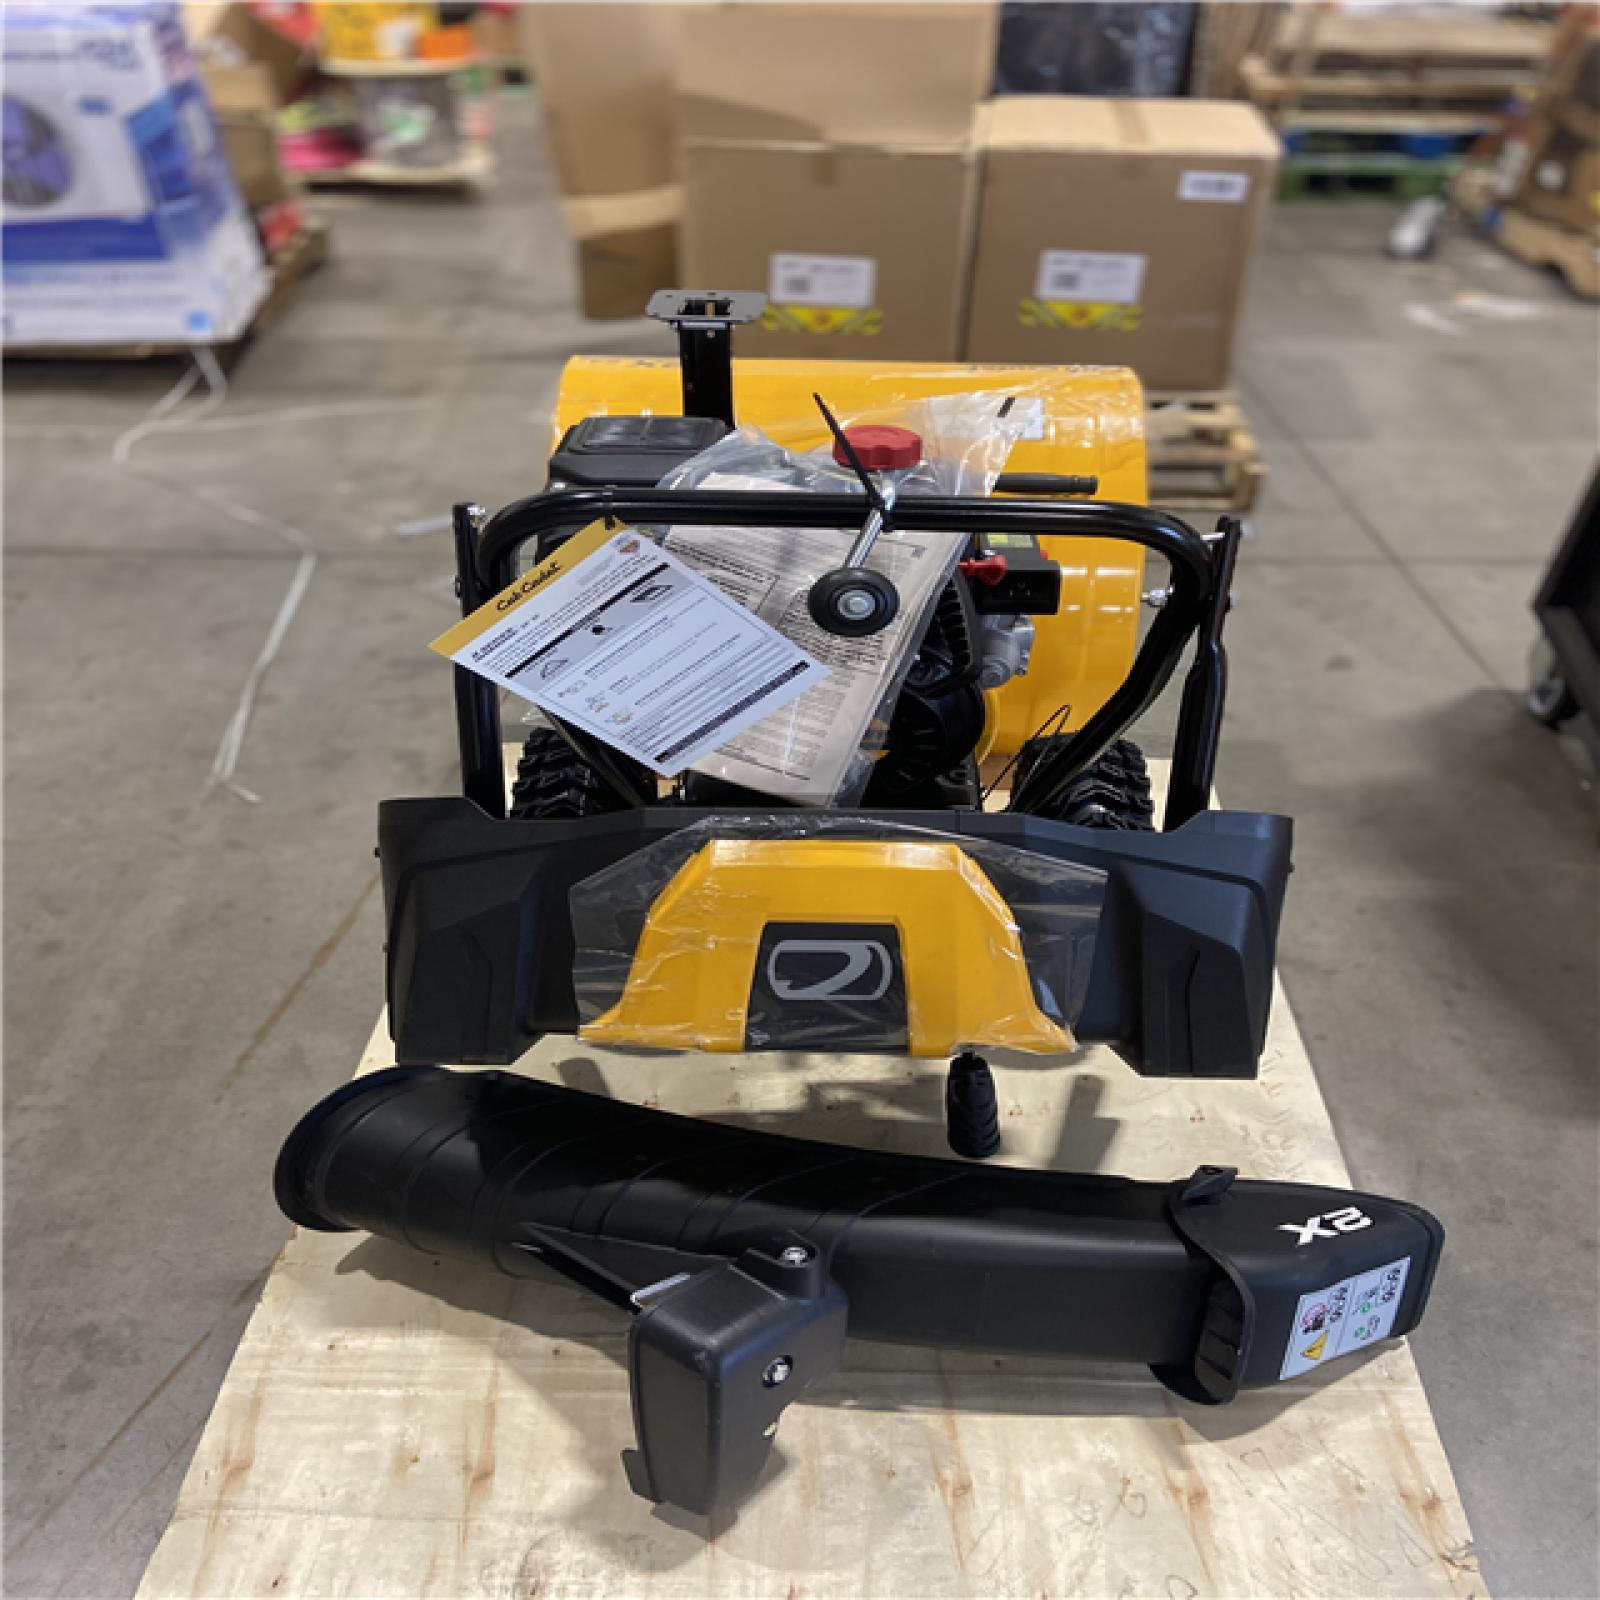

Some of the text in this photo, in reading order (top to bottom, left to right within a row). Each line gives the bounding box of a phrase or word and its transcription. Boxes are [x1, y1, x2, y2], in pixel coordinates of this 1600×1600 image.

[496, 590, 522, 611] Cub
[520, 561, 561, 592] Cadet
[1276, 1206, 1374, 1246] 2X
